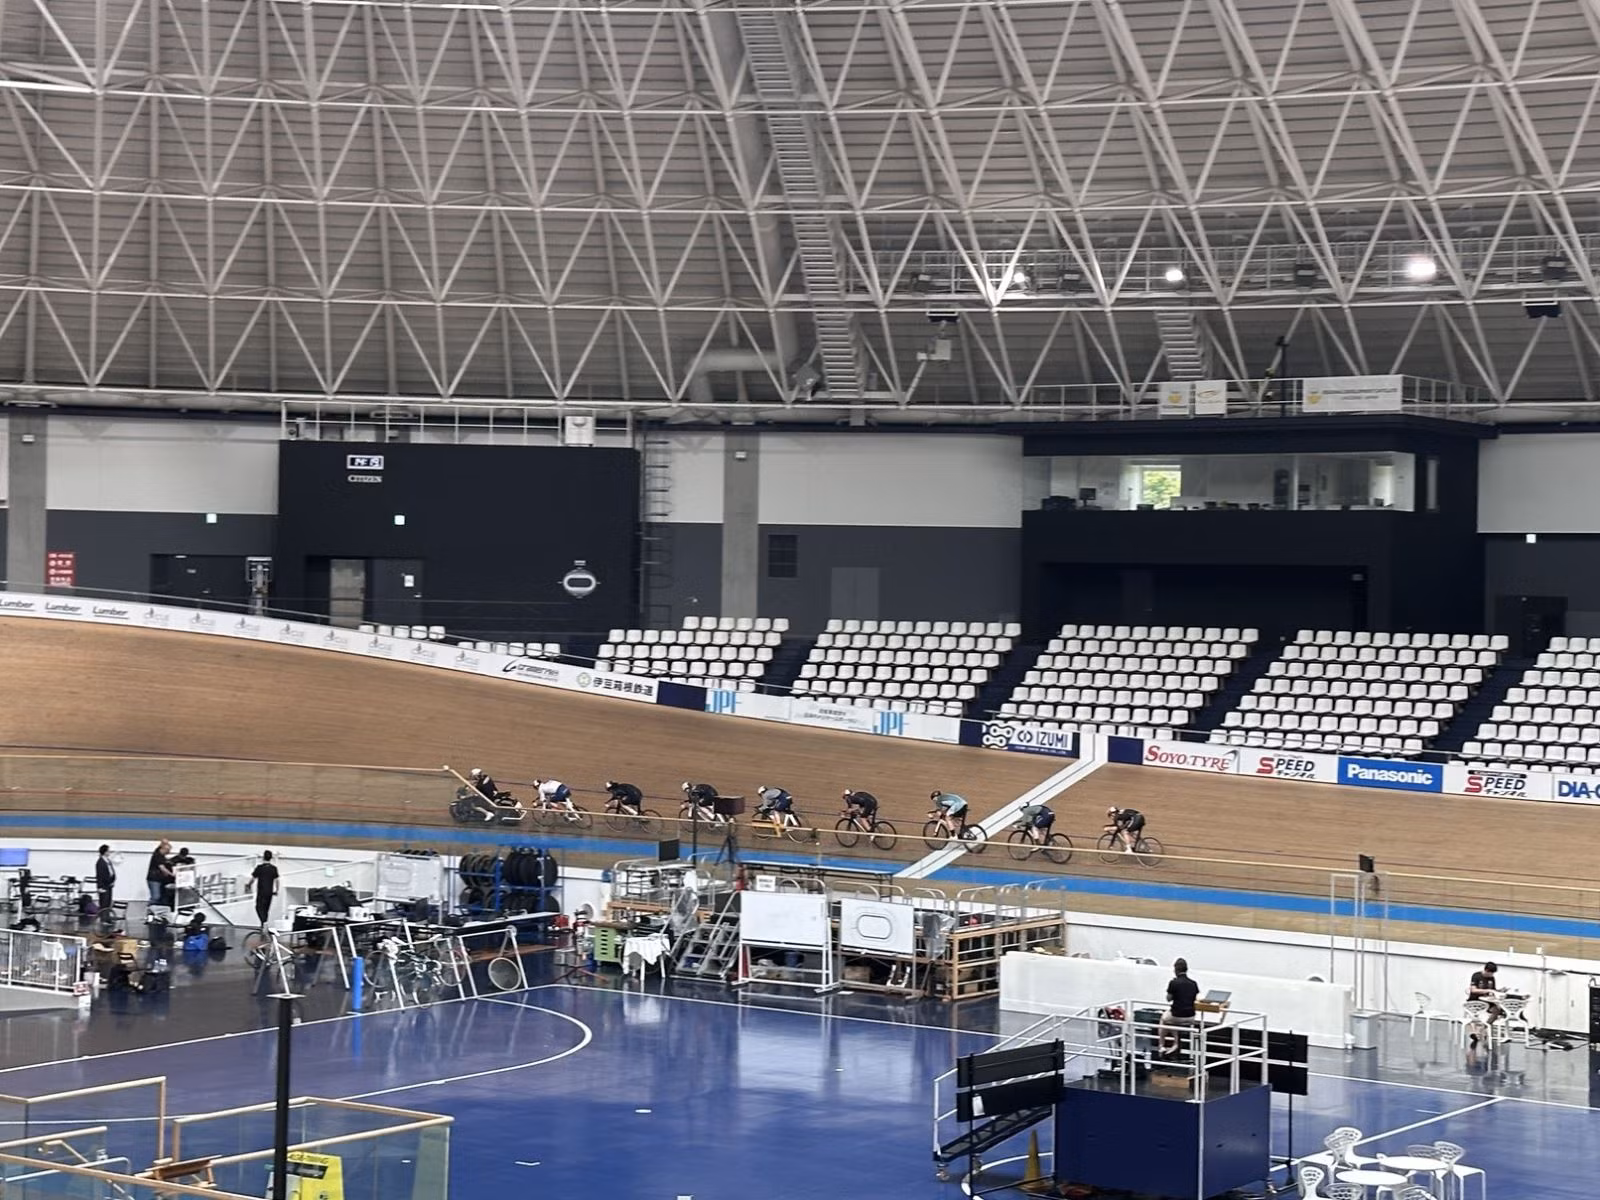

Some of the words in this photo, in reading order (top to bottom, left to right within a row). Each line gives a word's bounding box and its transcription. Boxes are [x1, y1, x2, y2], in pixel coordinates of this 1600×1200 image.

[45, 602, 82, 613] Lumber
[92, 606, 129, 617] Lumber
[1036, 731, 1068, 749] IZUMI
[1256, 756, 1316, 775] SPEED
[1347, 763, 1433, 786] Panasonic
[1464, 775, 1526, 794] SPEED
